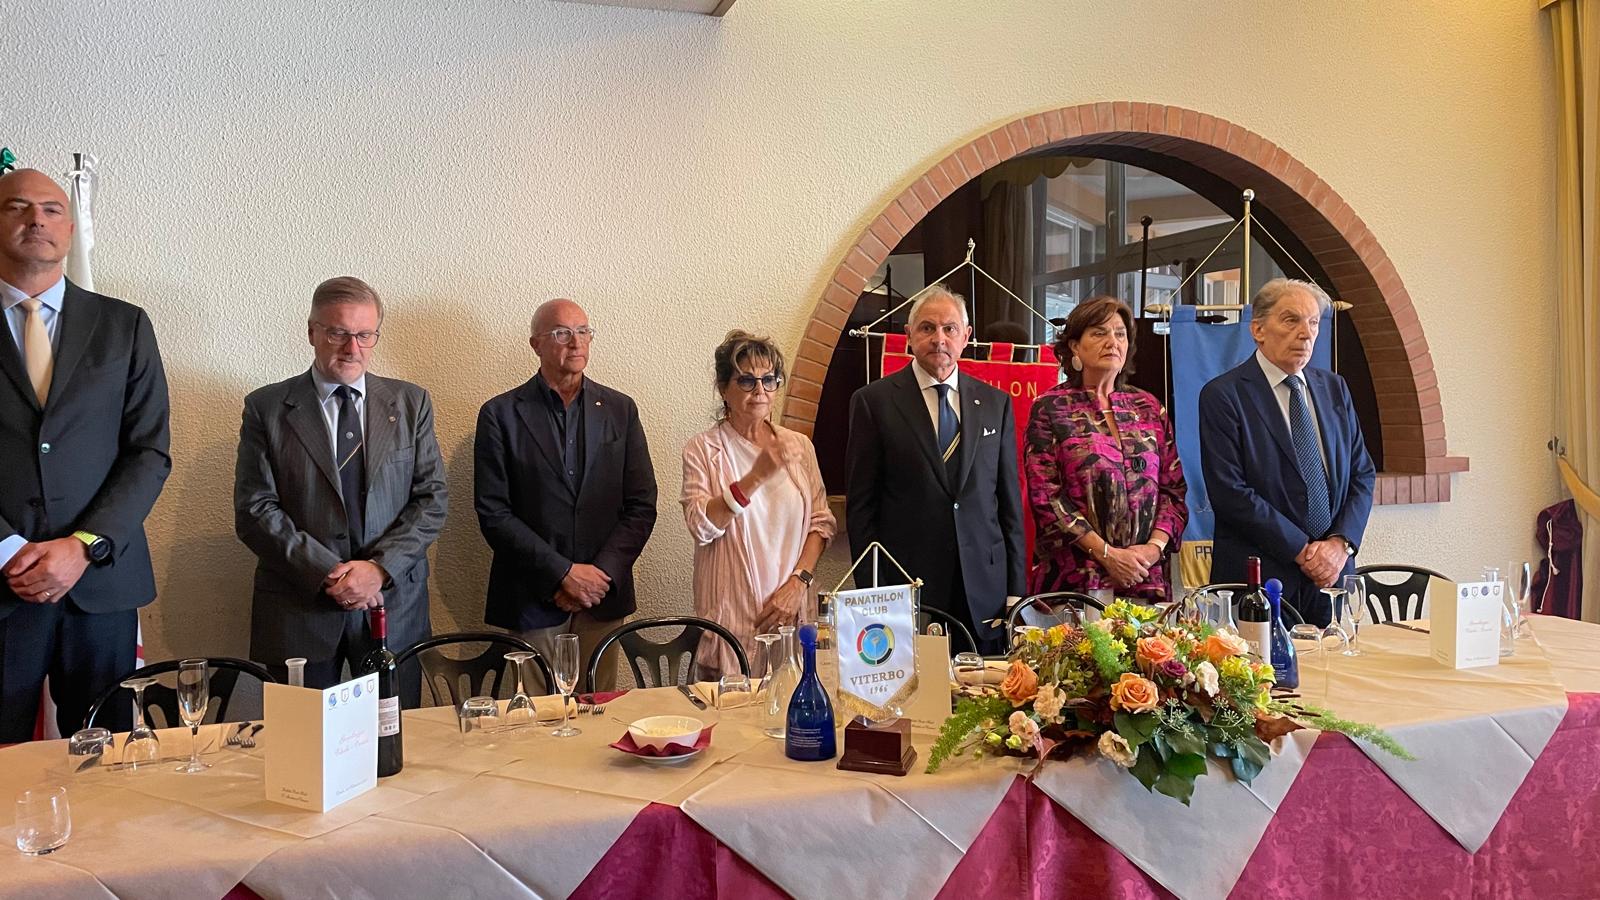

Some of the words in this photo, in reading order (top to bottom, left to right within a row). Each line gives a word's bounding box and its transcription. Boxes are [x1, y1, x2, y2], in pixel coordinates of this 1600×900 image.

[844, 592, 904, 607] PANATHLON
[862, 605, 888, 617] CLUB
[850, 669, 905, 686] VITERBO
